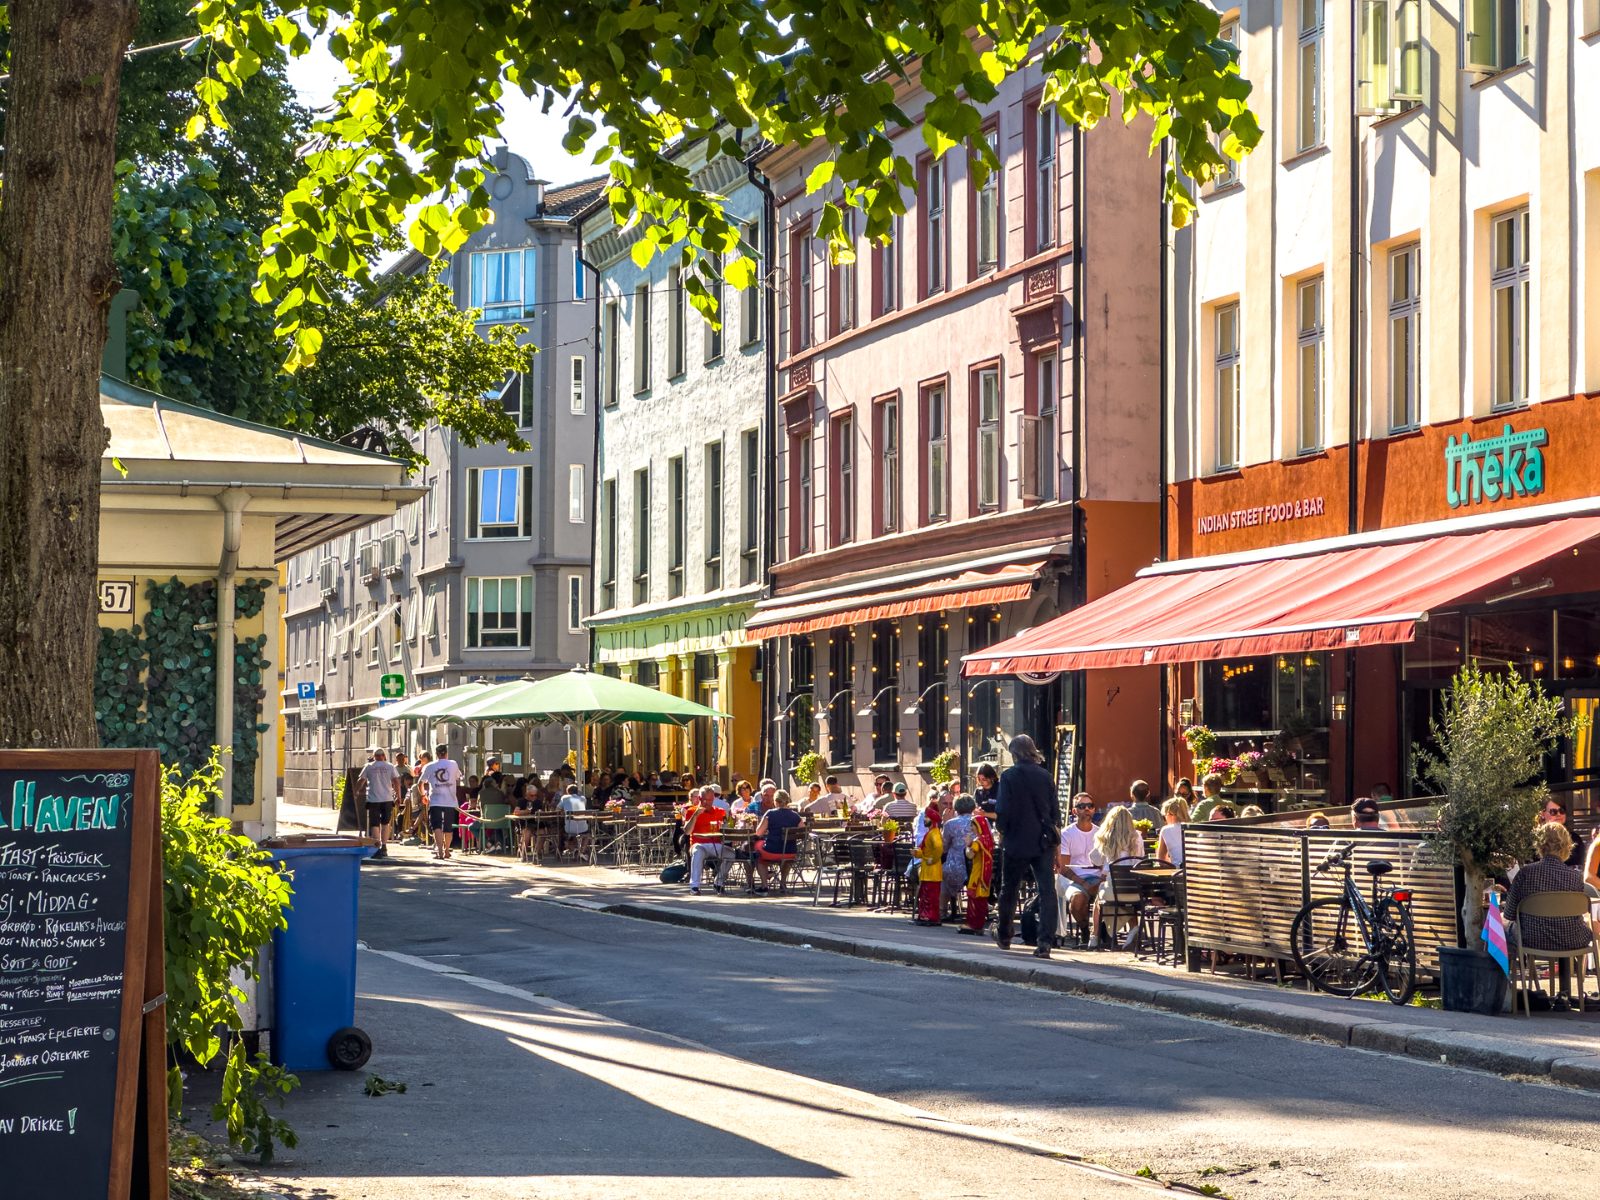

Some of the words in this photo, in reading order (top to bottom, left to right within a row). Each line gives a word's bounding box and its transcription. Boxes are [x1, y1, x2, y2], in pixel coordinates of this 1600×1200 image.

[1445, 423, 1545, 507] theka
[1198, 513, 1229, 534] INDIAN
[1231, 507, 1264, 528] STREET
[1265, 502, 1294, 523] FOOD
[1295, 500, 1302, 518] &
[1303, 497, 1324, 516] BAR
[104, 585, 128, 608] 57
[610, 628, 650, 658] VILLA
[663, 611, 747, 654] PARADISO
[301, 684, 311, 697] P
